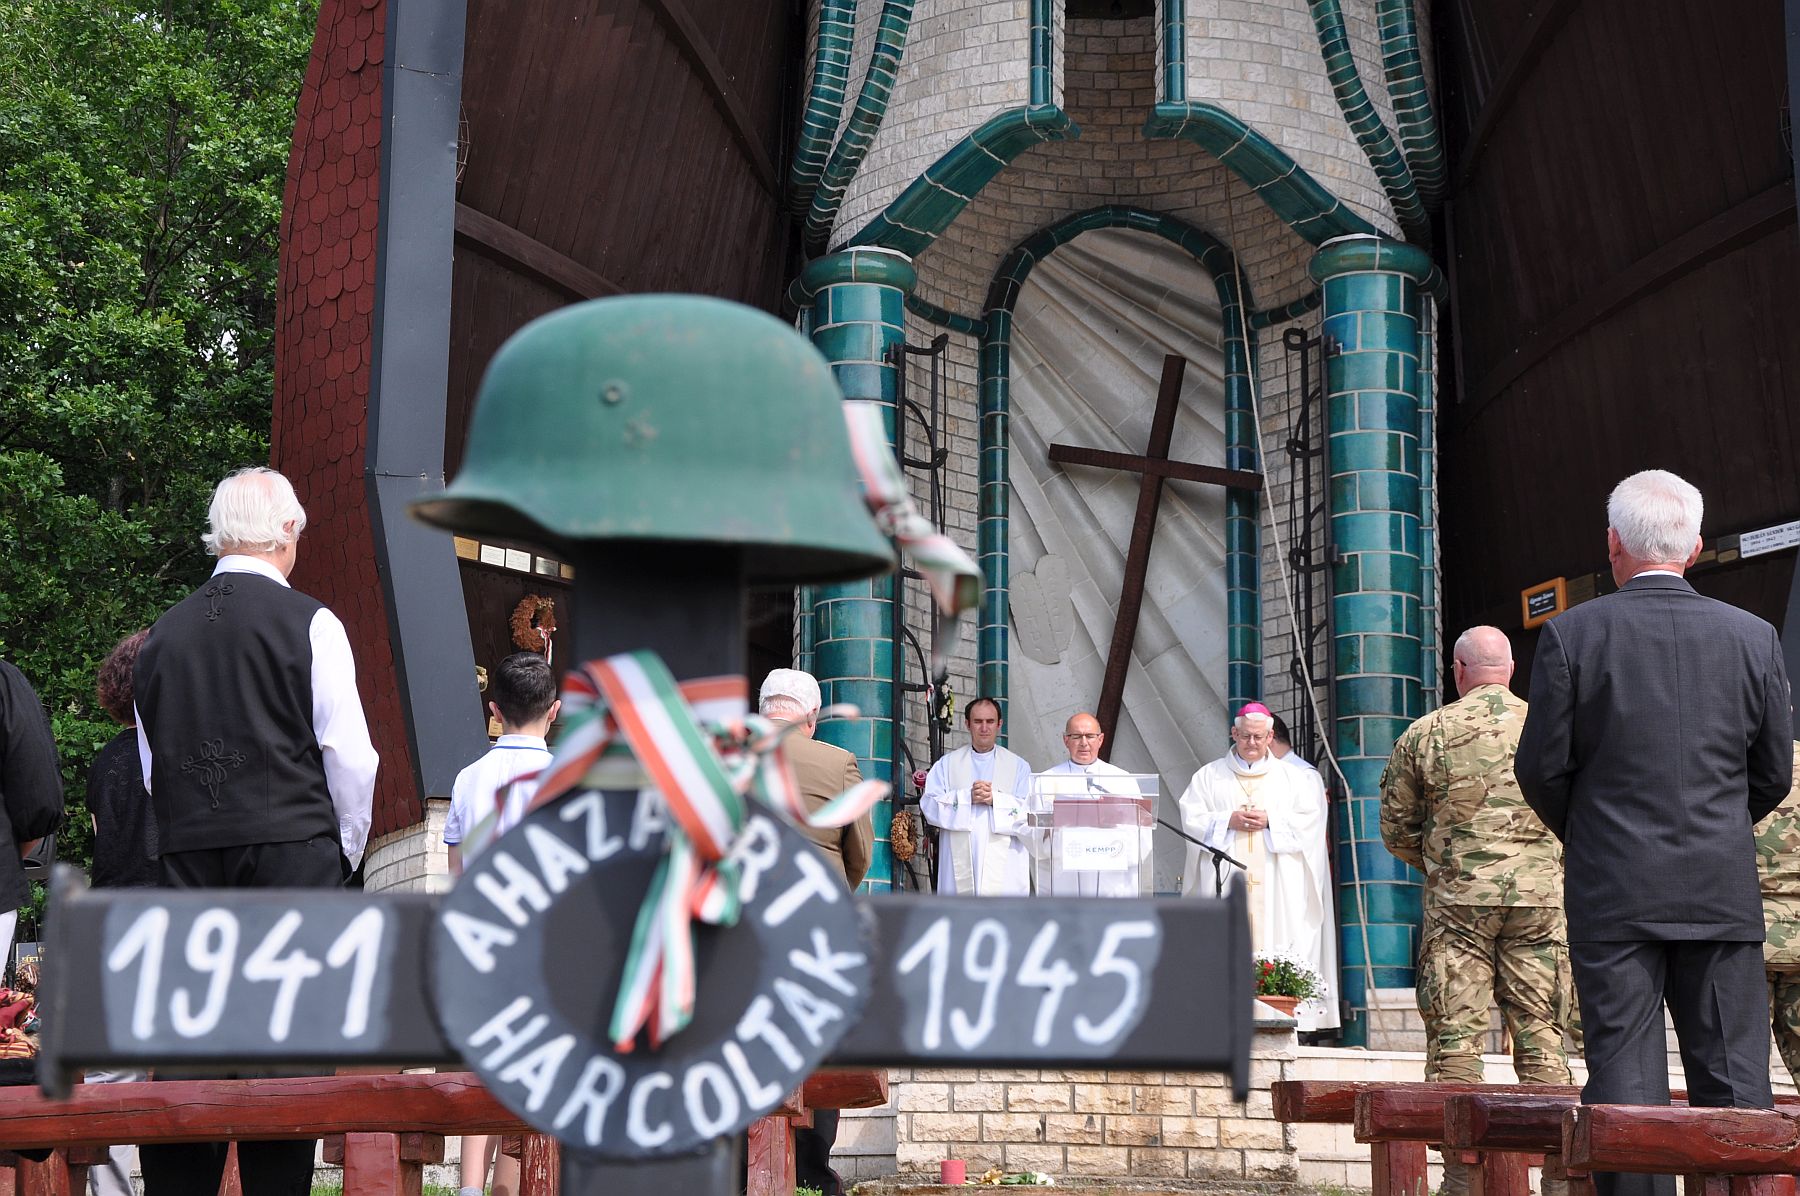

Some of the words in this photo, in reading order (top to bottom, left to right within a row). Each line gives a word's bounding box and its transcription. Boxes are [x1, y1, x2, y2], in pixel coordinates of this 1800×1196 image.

[108, 906, 384, 1042] 1941
[466, 927, 868, 1147] HARCOLTAK
[898, 917, 1156, 1049] 1945
